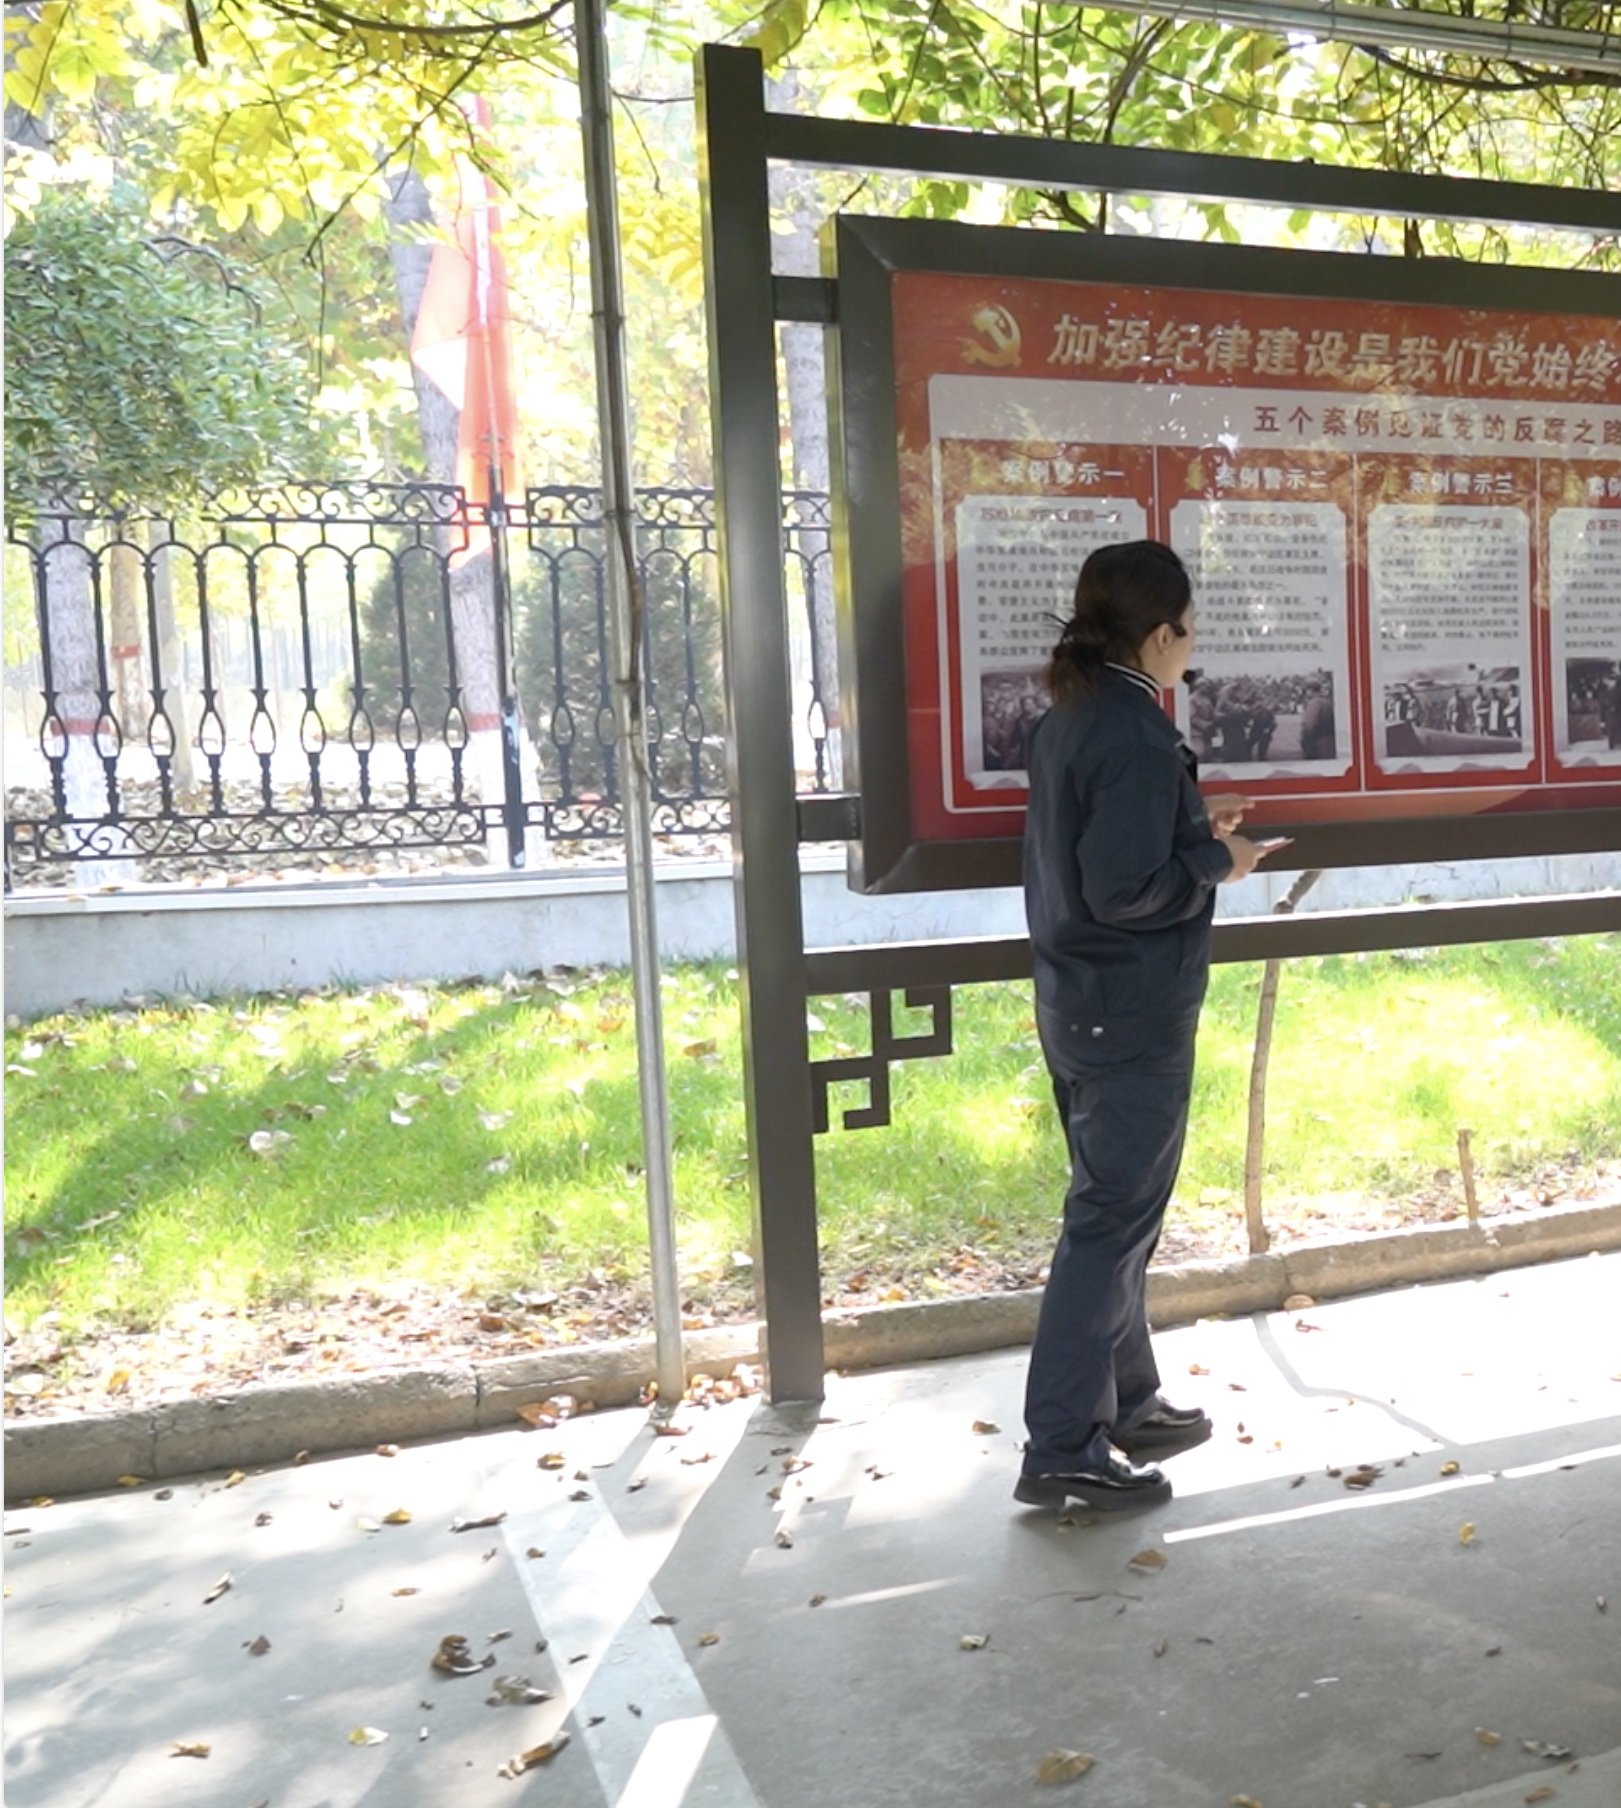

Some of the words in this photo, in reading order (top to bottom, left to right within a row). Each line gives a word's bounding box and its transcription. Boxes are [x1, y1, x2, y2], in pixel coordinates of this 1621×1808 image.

[1215, 465, 1328, 490] 案例警示二
[1408, 470, 1513, 495] 案例警示三
